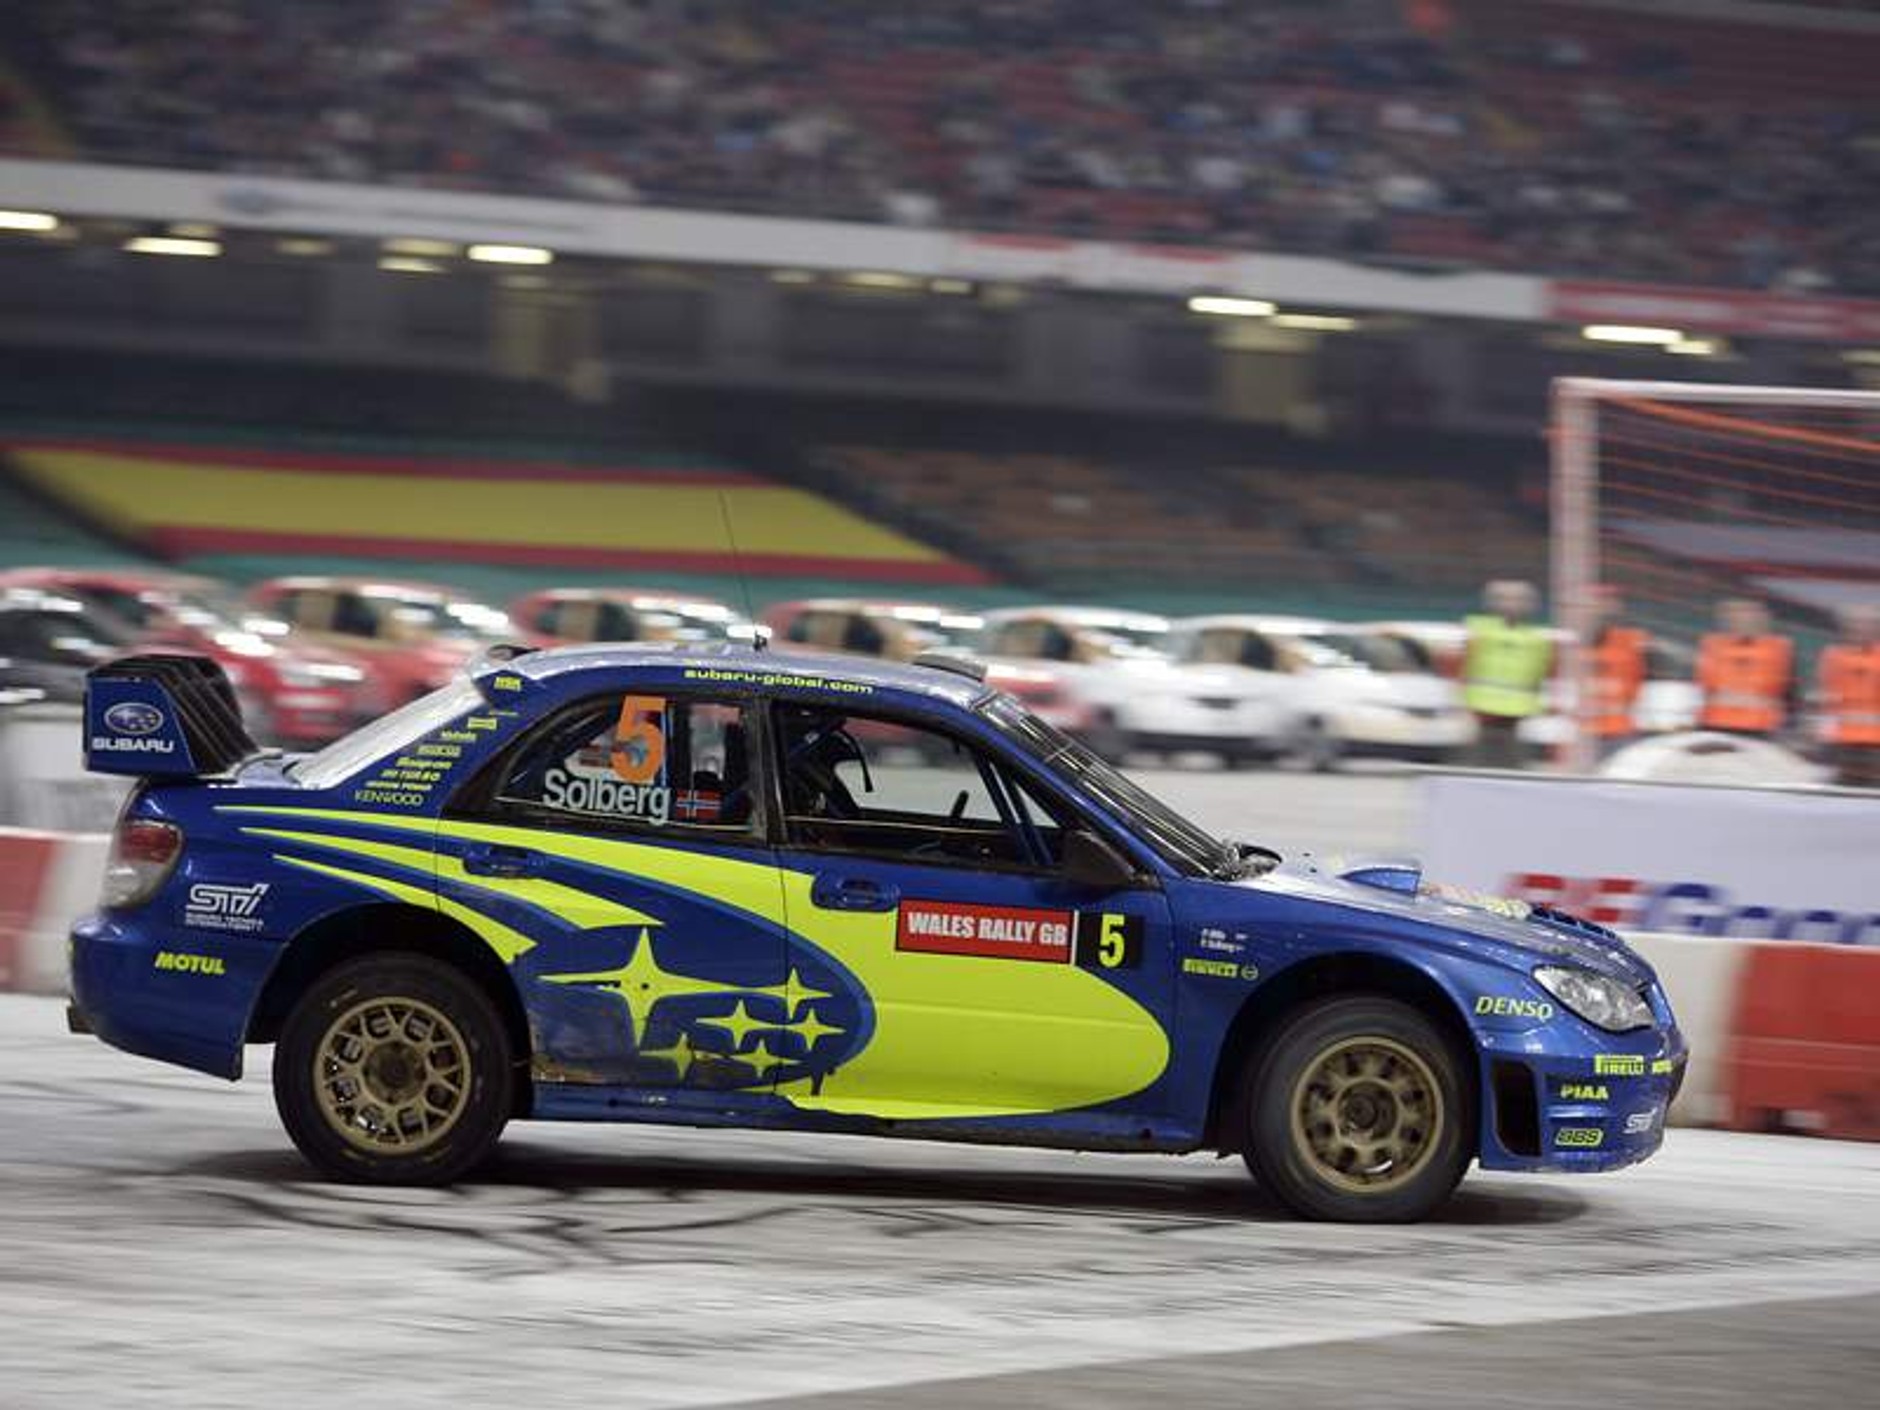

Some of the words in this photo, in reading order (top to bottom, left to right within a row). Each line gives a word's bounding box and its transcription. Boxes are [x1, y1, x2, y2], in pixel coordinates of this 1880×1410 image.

[684, 669, 874, 694] subaru-global.com
[91, 736, 175, 753] SUBARU
[611, 695, 667, 782] 5
[354, 789, 424, 806] KENWOOD
[543, 767, 672, 826] Solberg
[907, 911, 976, 938] WALES
[977, 917, 1037, 943] RALLY
[1038, 922, 1068, 946] GB
[1099, 913, 1126, 969] 5
[154, 951, 226, 975] MOTUL
[1474, 995, 1553, 1021] DENSO
[1594, 1055, 1644, 1076] PIRELLI
[1560, 1084, 1609, 1100] PIAA
